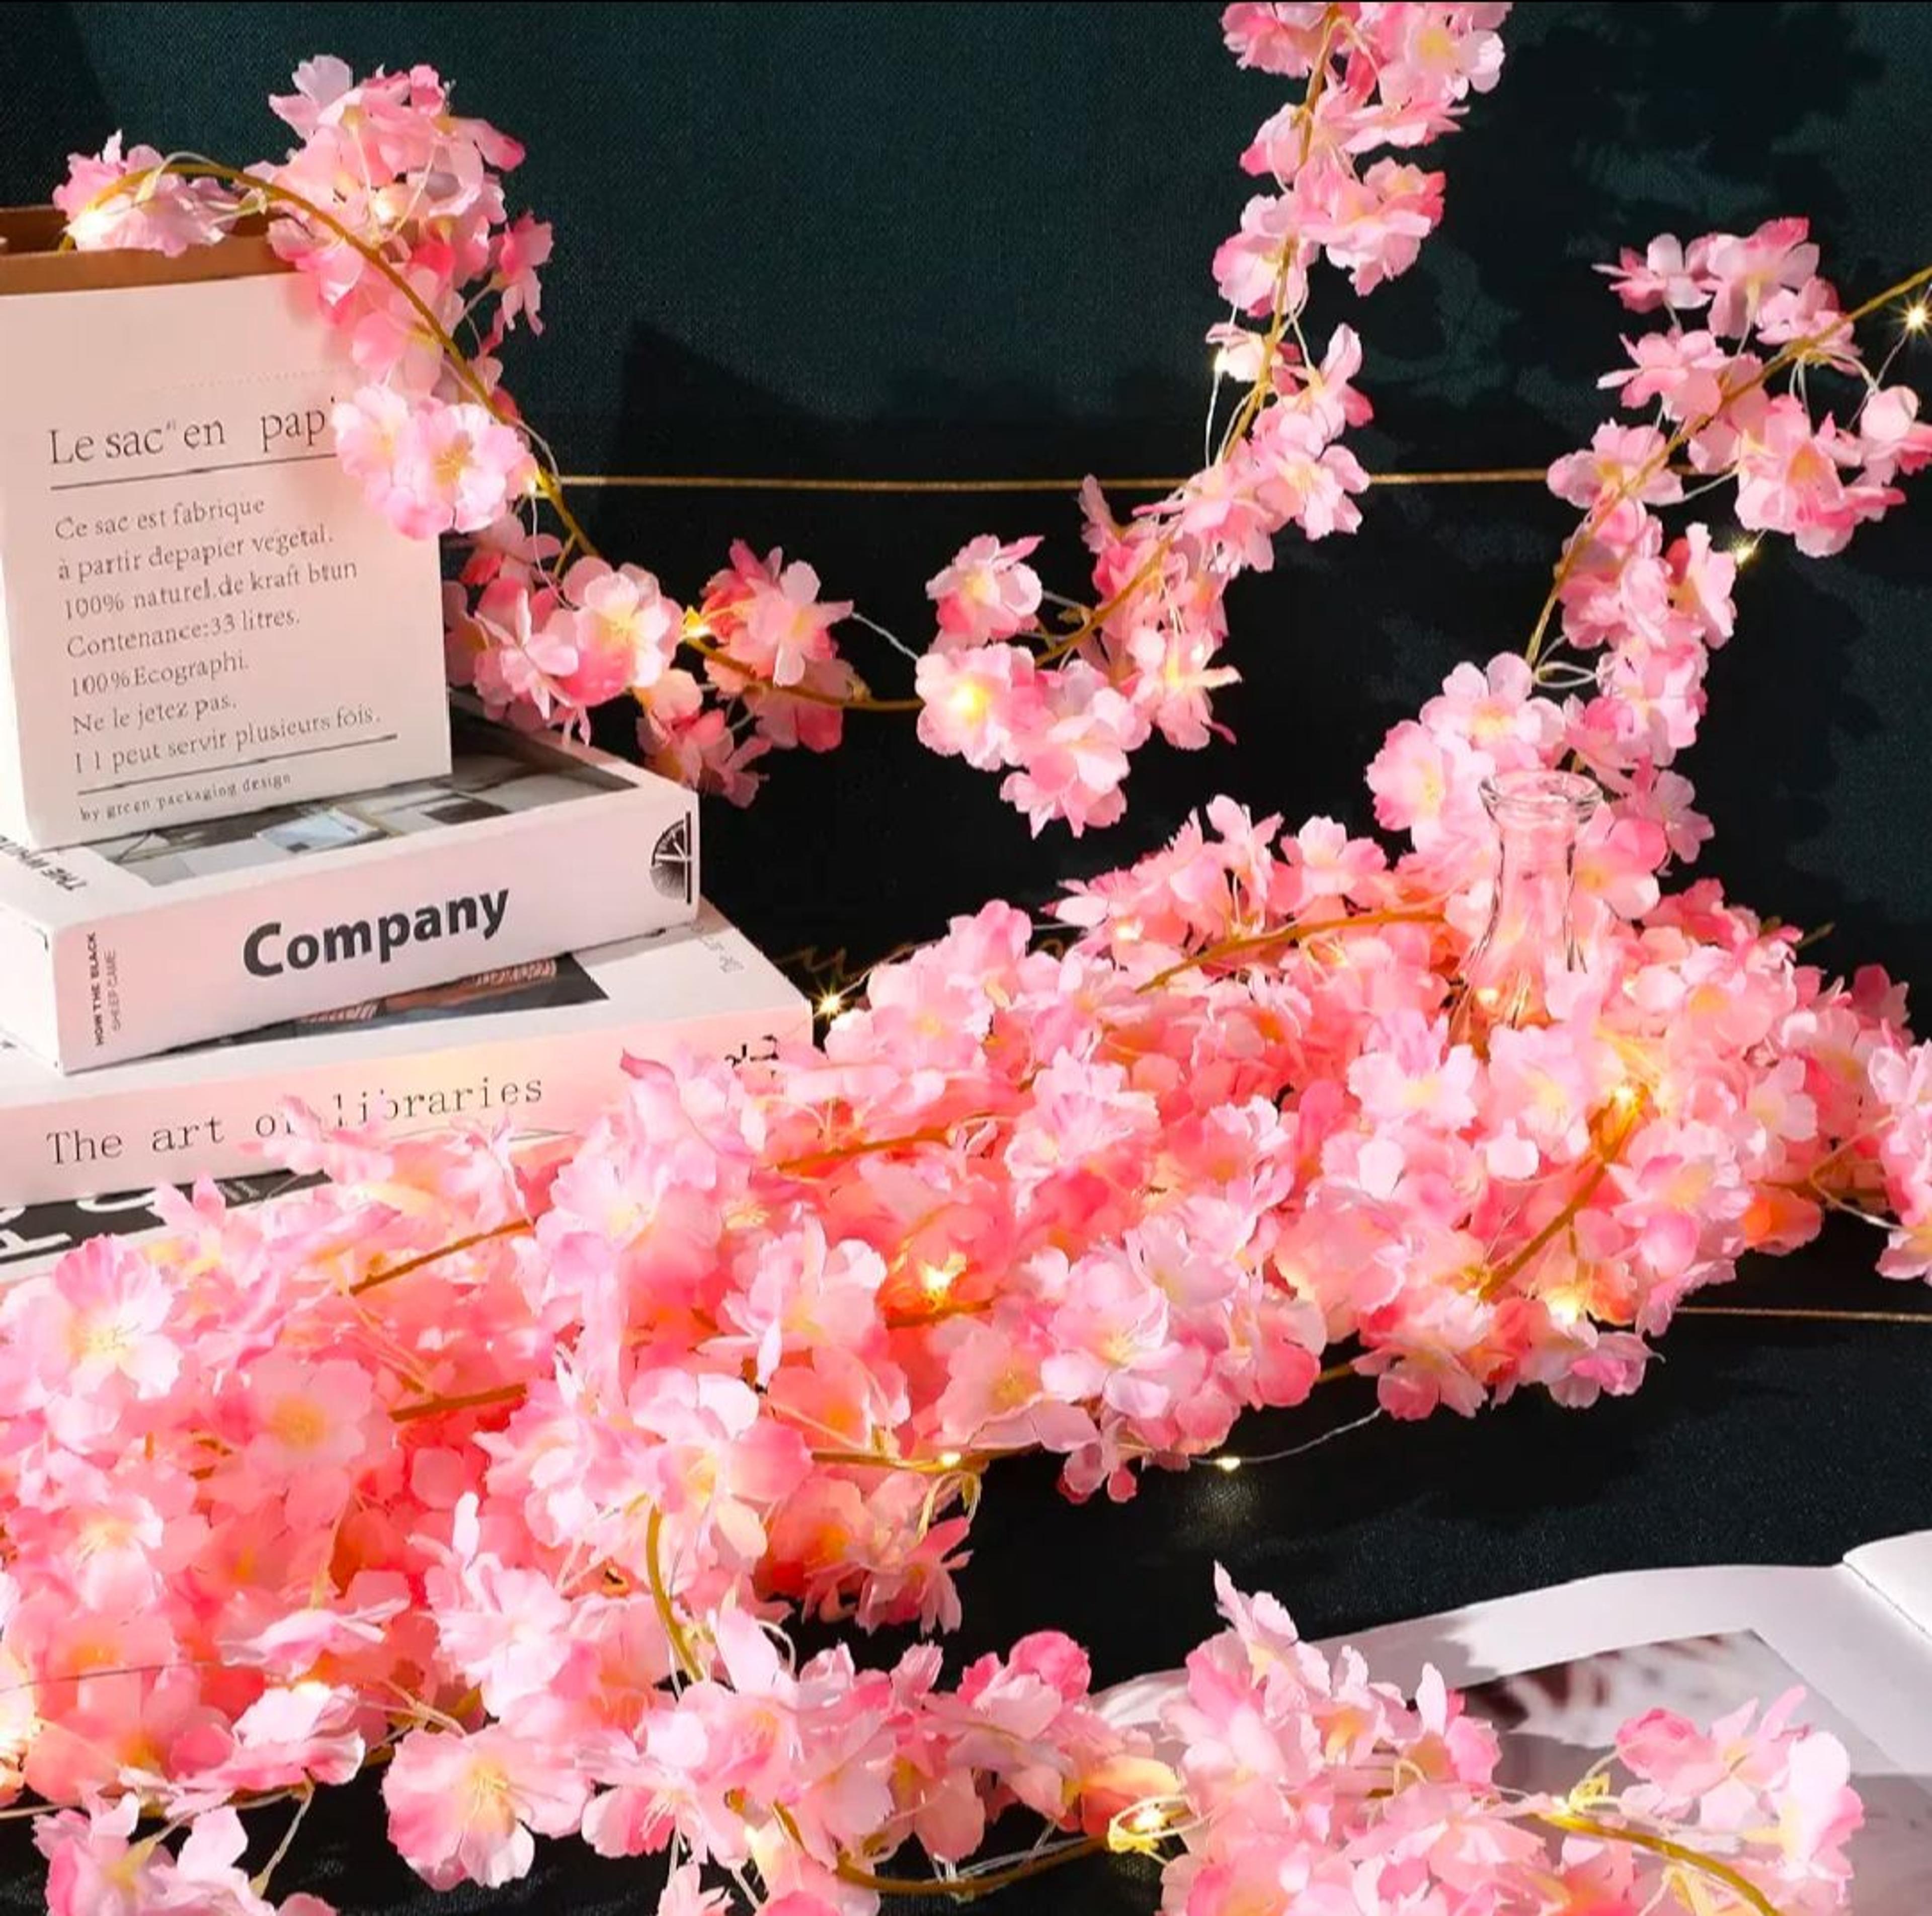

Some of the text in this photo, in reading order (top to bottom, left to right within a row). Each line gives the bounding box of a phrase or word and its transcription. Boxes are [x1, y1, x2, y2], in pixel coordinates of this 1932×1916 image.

[49, 428, 94, 463] Le
[183, 419, 226, 449] en
[260, 395, 334, 452] pap
[55, 516, 87, 540] Ce
[96, 516, 129, 535] sac
[137, 508, 166, 529] est
[78, 550, 140, 584] partir
[65, 592, 125, 620] 100%
[249, 563, 300, 591] kraft
[242, 608, 301, 632] litres.
[72, 713, 104, 735] Ne
[113, 706, 130, 729] le
[137, 702, 189, 731] jetez
[113, 743, 161, 775] peut
[169, 730, 226, 757] servir
[235, 714, 331, 753] plusieurs
[79, 805, 101, 823] by
[106, 799, 151, 821] green
[243, 889, 509, 977] Company
[91, 983, 101, 1013] THE
[46, 1130, 124, 1165] The
[151, 1116, 224, 1153] art
